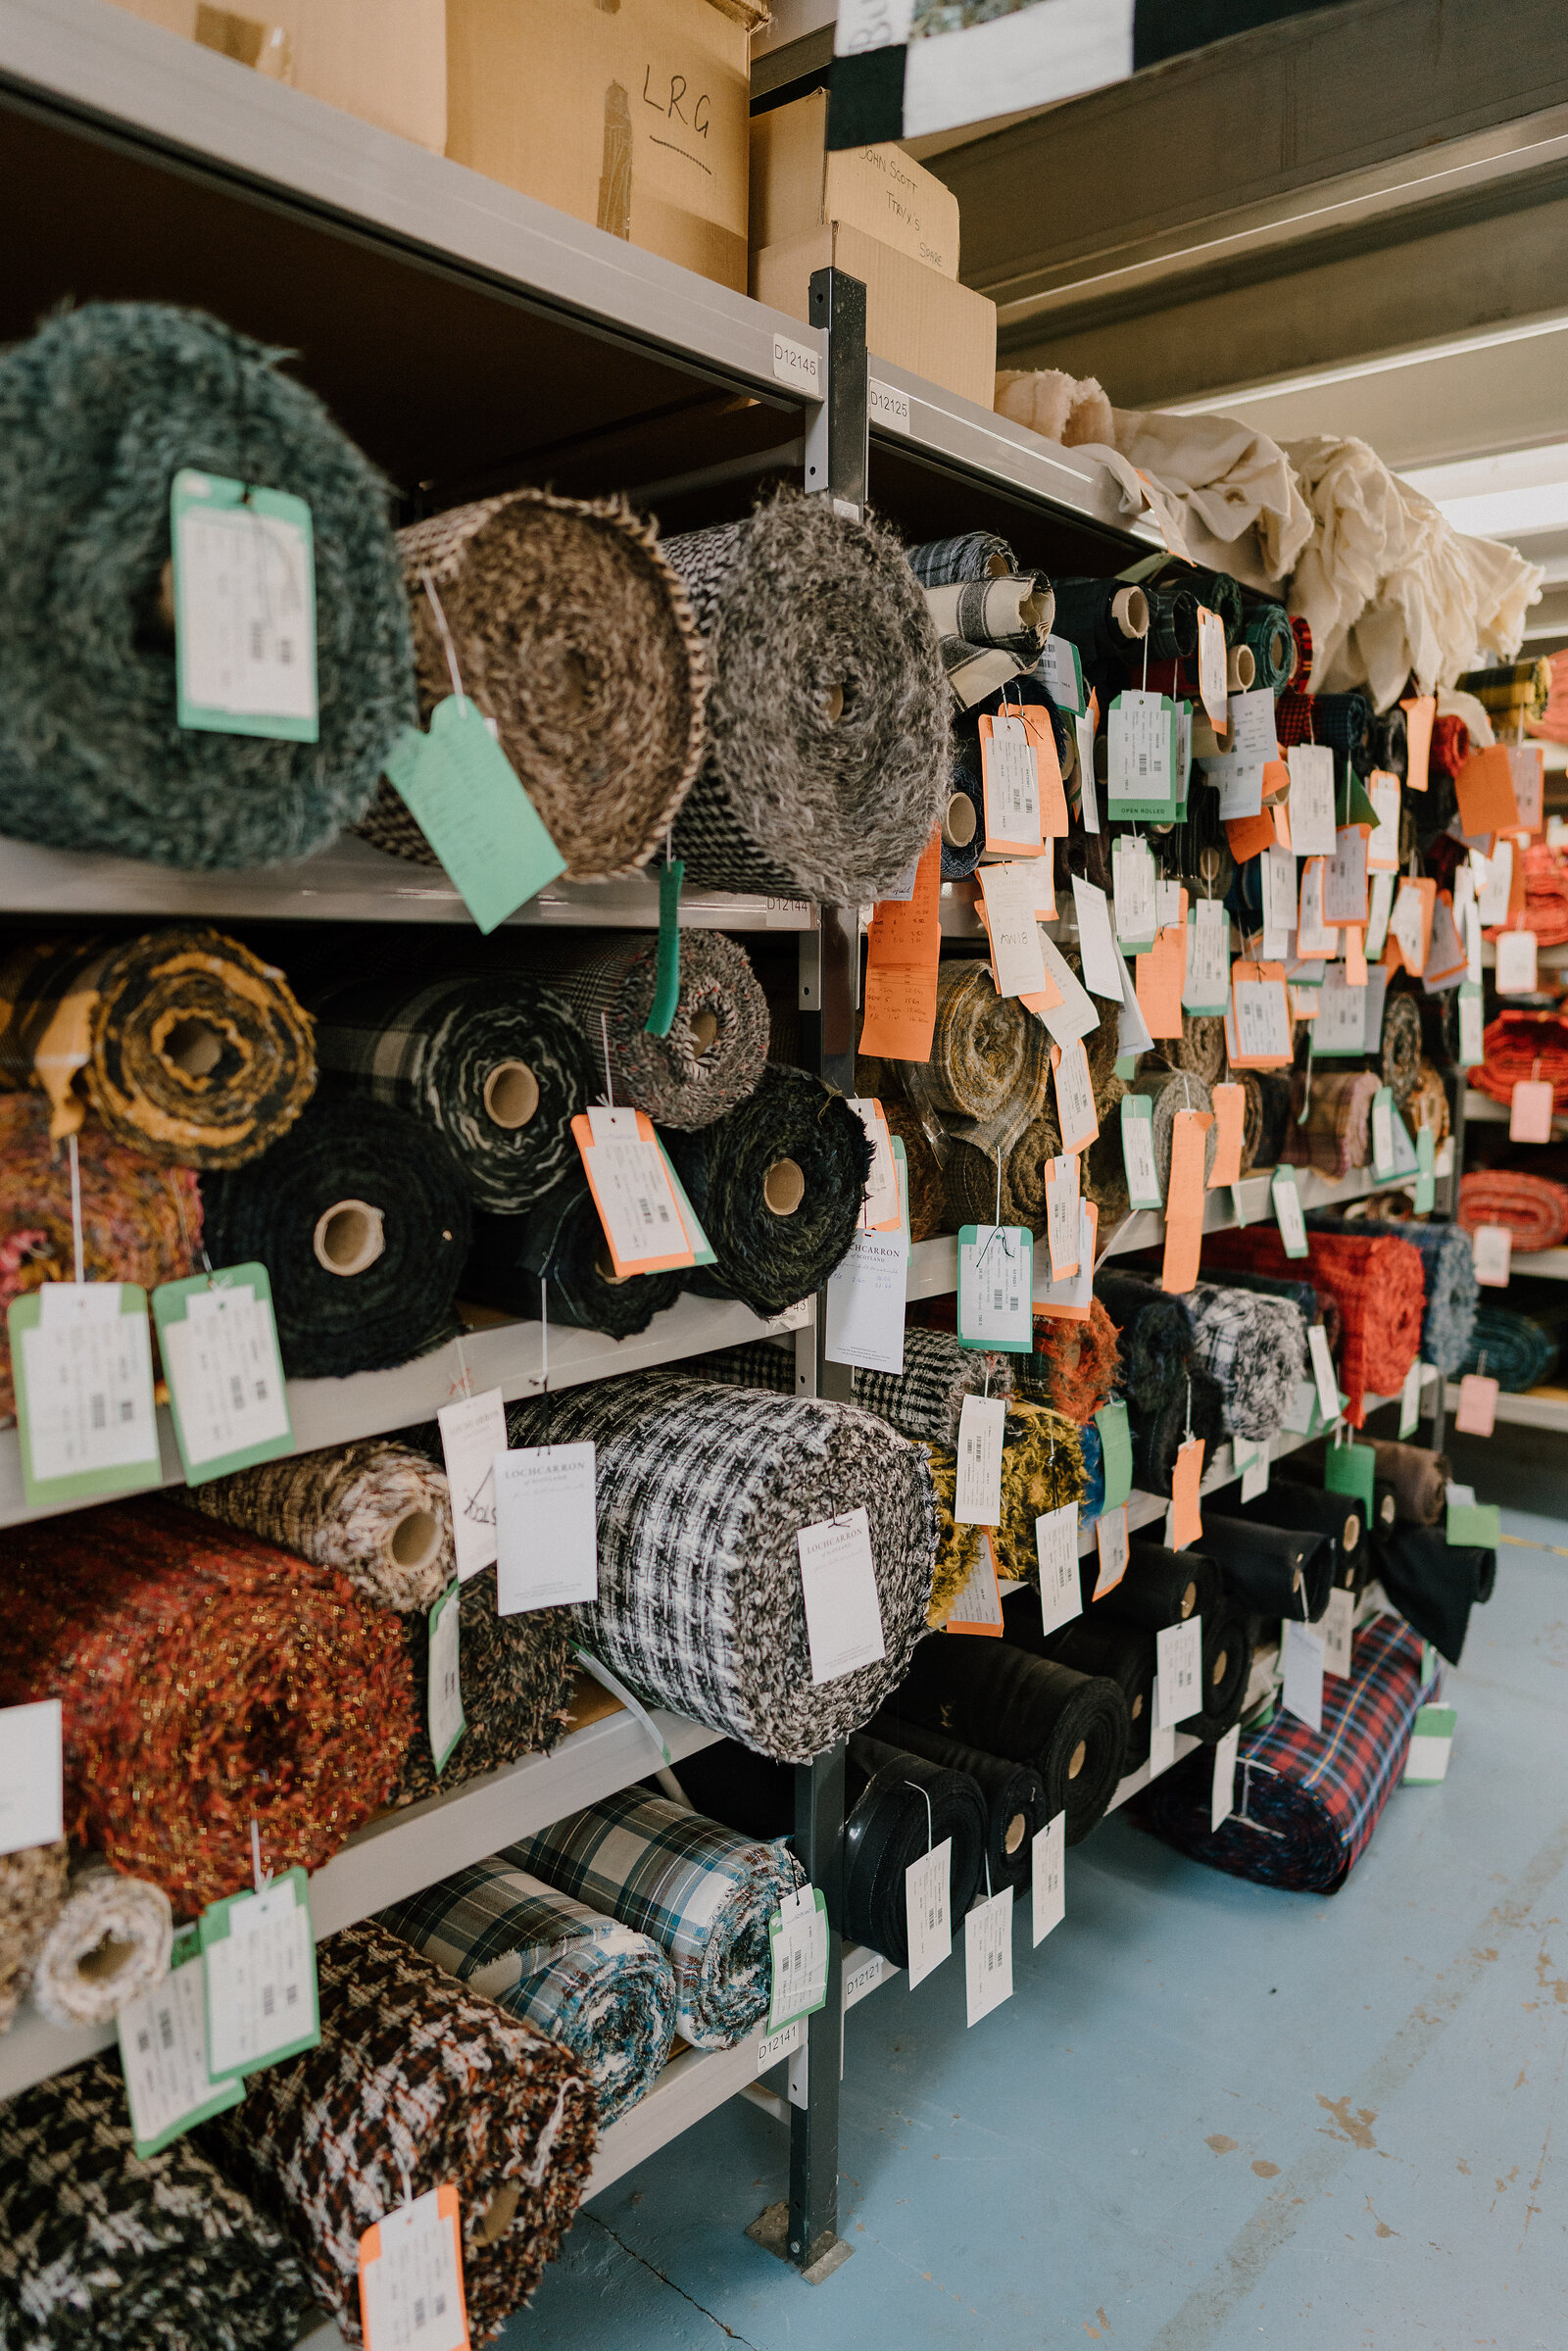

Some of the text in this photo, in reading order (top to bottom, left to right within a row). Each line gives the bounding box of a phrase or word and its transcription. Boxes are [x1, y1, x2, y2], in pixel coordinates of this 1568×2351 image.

[643, 64, 711, 139] LRG
[858, 146, 918, 195] JOHN SCOTT
[774, 344, 816, 375] D12145
[870, 390, 907, 417] D12125
[767, 897, 808, 912] D12144
[850, 1244, 901, 1258] HCARRON
[856, 1254, 886, 1263] SCOTLAND
[505, 1461, 585, 1480] LOCHCARRON
[807, 1528, 863, 1554] LOCHCARRON
[848, 1962, 879, 1995] D12121
[760, 2025, 796, 2060] D12141
